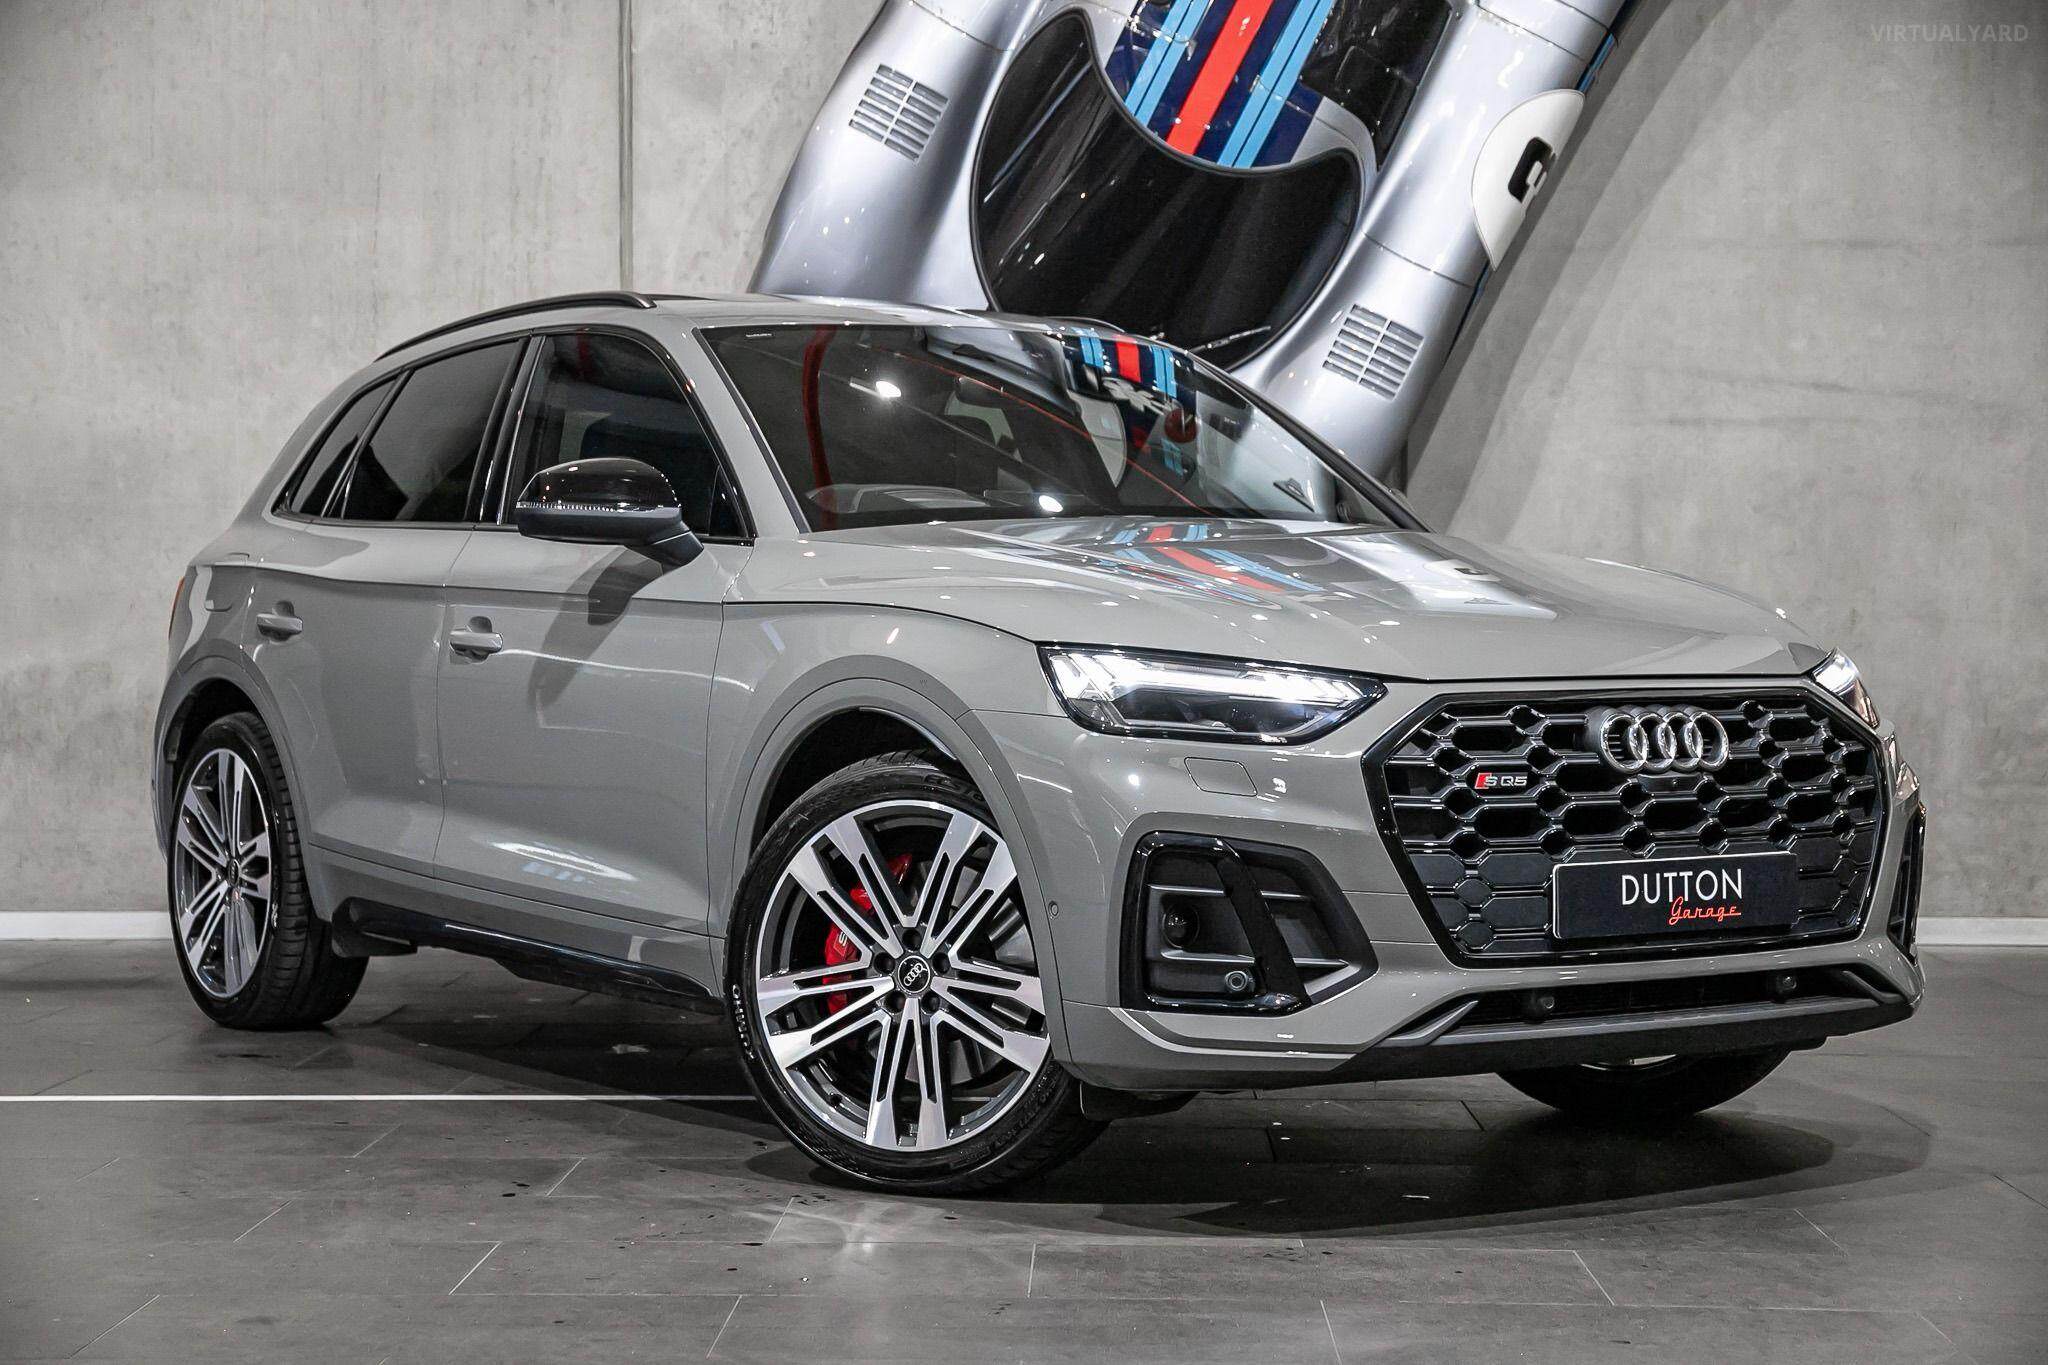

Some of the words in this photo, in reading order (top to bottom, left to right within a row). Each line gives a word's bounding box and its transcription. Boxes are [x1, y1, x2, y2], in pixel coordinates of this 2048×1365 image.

[1483, 775, 1528, 787] SQ5
[1621, 868, 1743, 905] DUTTON
[1668, 896, 1742, 926] Garage
